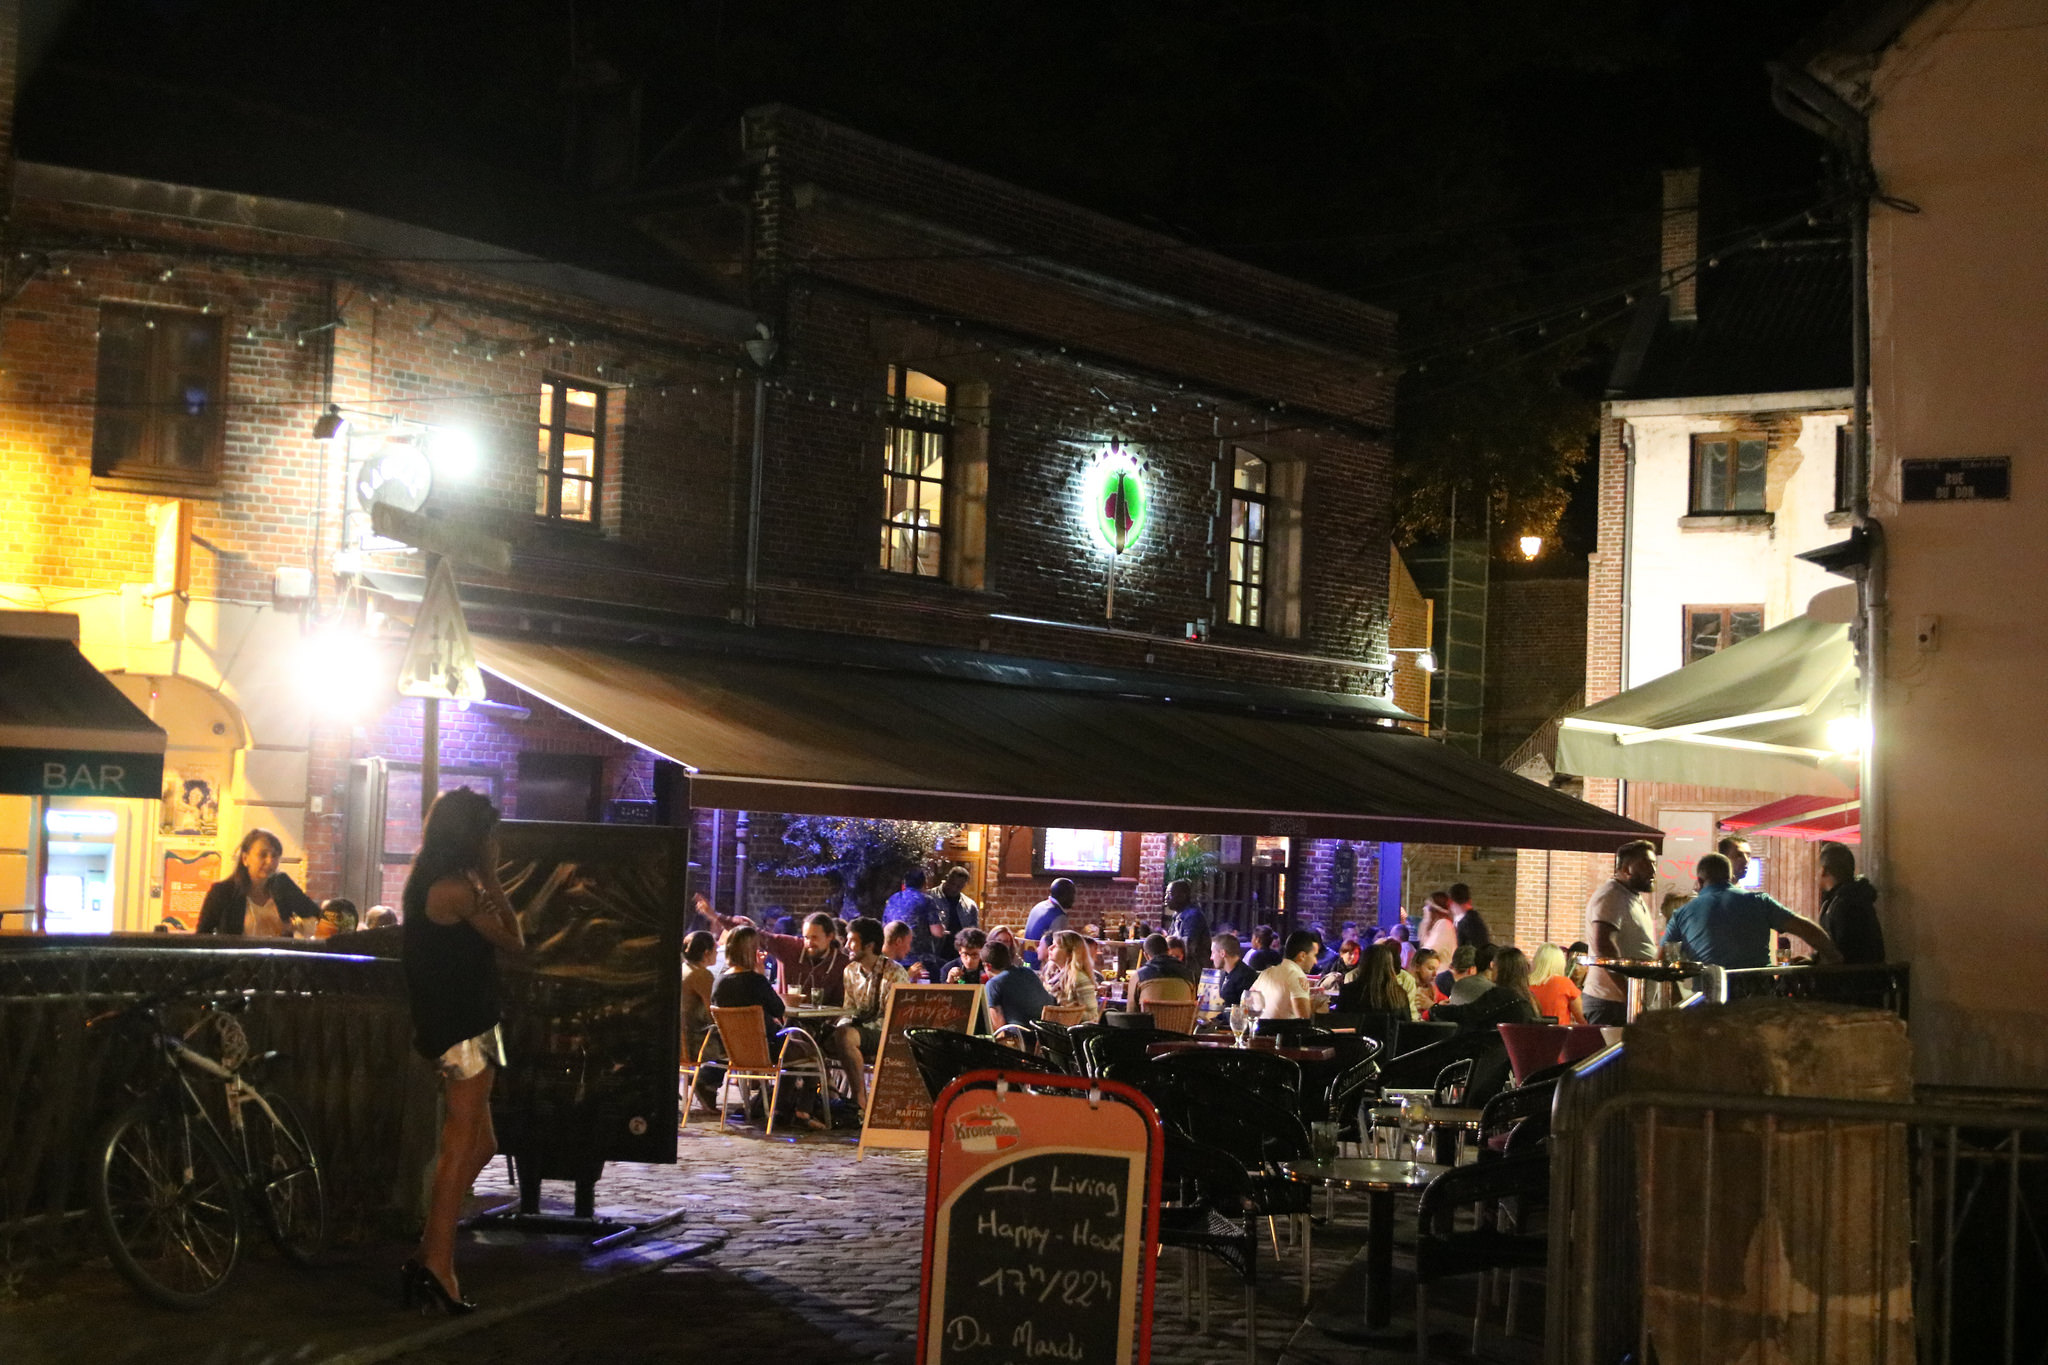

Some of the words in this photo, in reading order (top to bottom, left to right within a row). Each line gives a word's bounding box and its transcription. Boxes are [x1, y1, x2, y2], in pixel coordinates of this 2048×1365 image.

[1945, 472, 1965, 485] RUE
[1935, 486, 1950, 499] DU
[43, 762, 126, 791] BAR
[895, 1109, 926, 1118] MARTINI
[984, 1165, 1037, 1193] Le
[1050, 1165, 1120, 1217] Living
[946, 1315, 992, 1352] Du
[1011, 1320, 1084, 1361] Mardi
